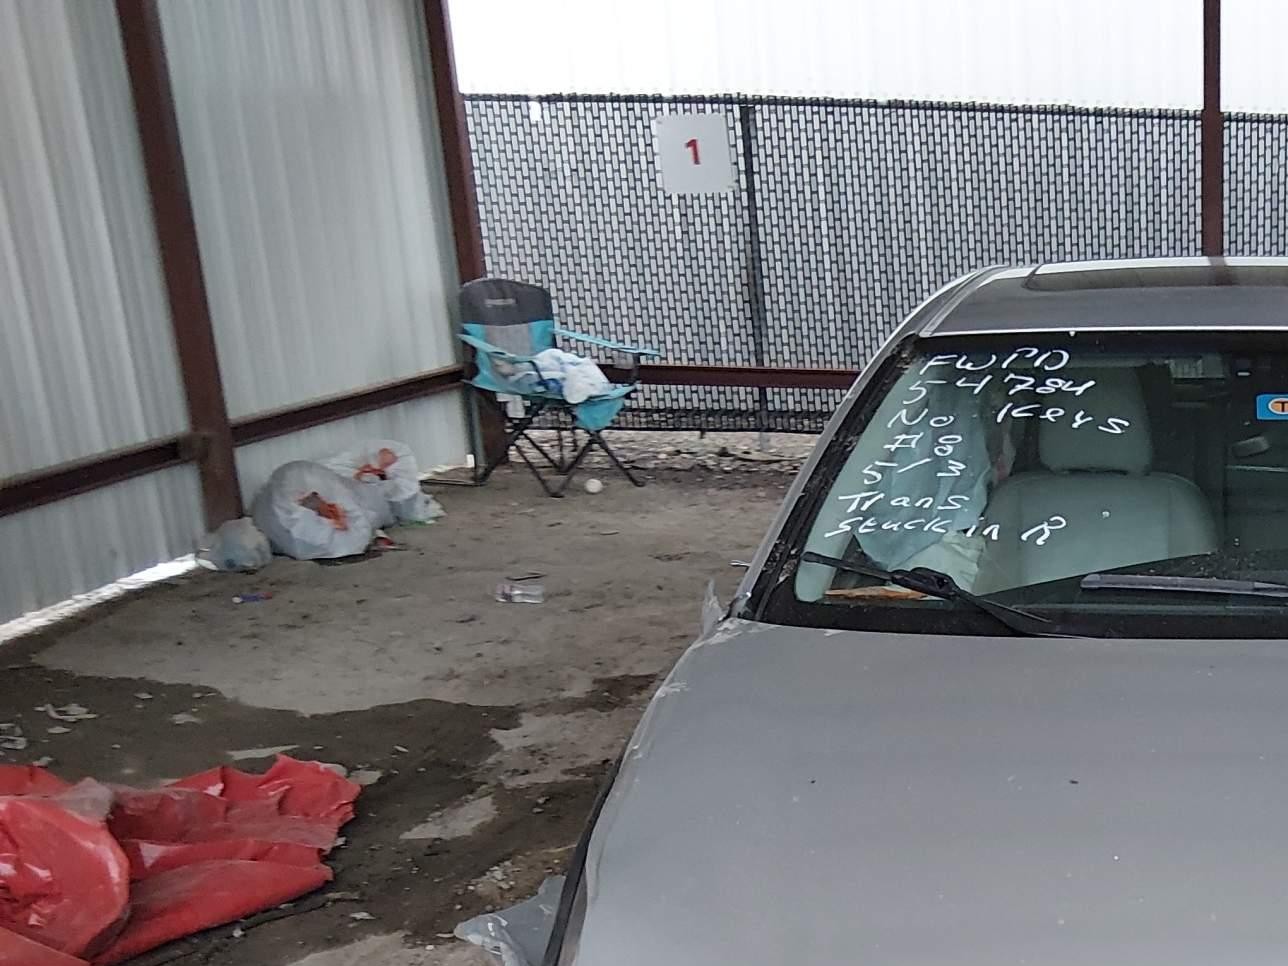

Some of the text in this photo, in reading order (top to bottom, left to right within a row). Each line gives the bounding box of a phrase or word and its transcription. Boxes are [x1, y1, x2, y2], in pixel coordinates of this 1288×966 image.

[685, 138, 701, 165] 1
[887, 408, 955, 428] No
[965, 516, 1000, 540] in
[1020, 515, 1067, 546] R
